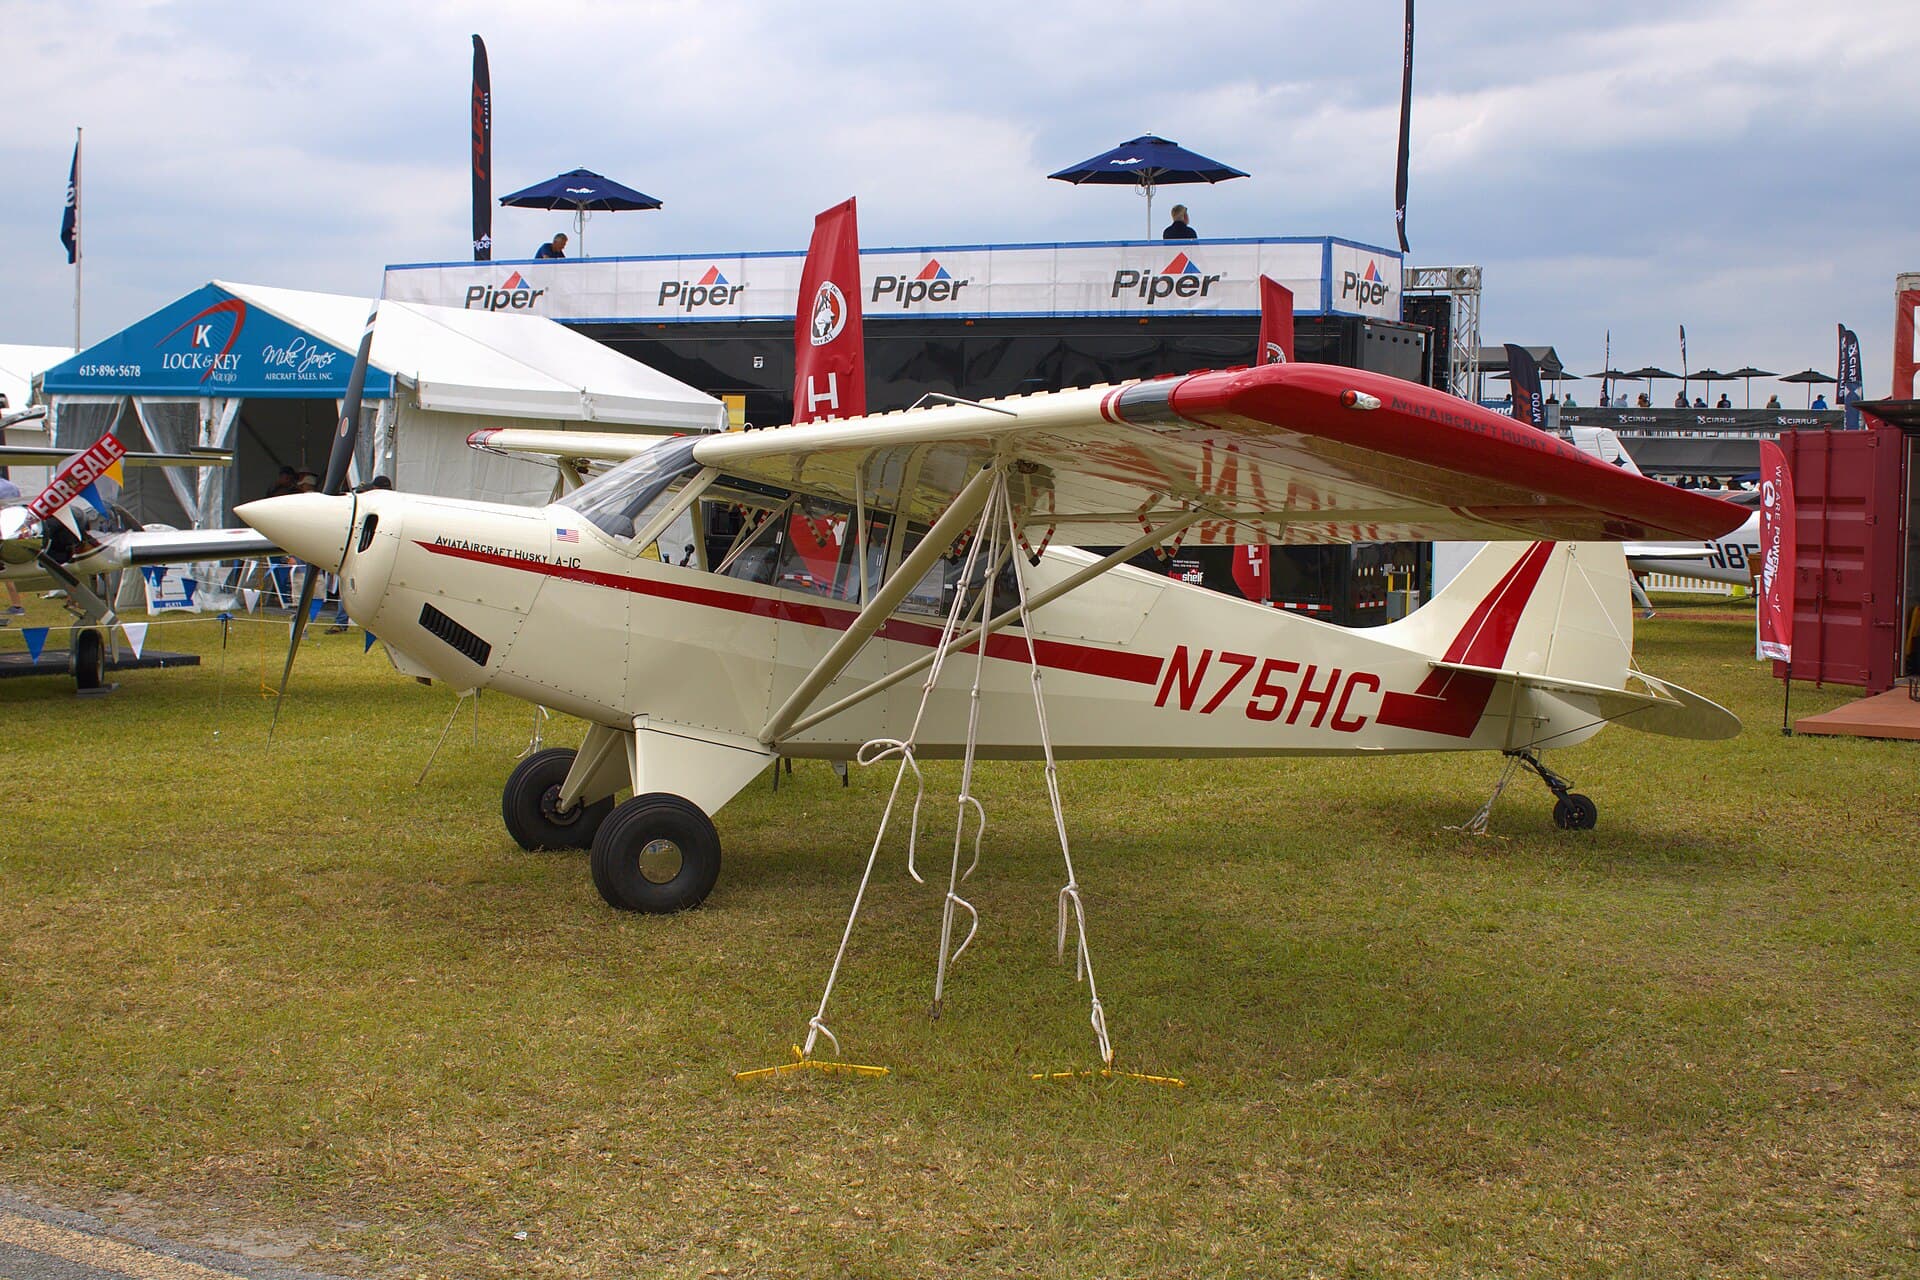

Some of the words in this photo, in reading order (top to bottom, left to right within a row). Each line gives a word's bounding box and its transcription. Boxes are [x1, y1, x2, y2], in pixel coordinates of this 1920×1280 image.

[465, 284, 545, 312] Piper
[658, 280, 744, 312] Piper
[872, 275, 967, 309] Piper
[1111, 269, 1219, 304] Piper
[1342, 271, 1389, 309] Piper
[262, 337, 304, 367] Mike
[299, 346, 336, 372] Jones
[265, 373, 296, 381] AIRCRAFT
[319, 373, 333, 381] INC.
[1531, 392, 1541, 423] M700
[1628, 415, 1657, 423] CIRRUS
[1706, 416, 1736, 424] CIRRUS
[1787, 416, 1818, 425] CIRRUS
[32, 479, 77, 516] FOR
[70, 437, 124, 485] SALE
[514, 549, 548, 564] HUSKY
[1153, 645, 1381, 732] N75HC
